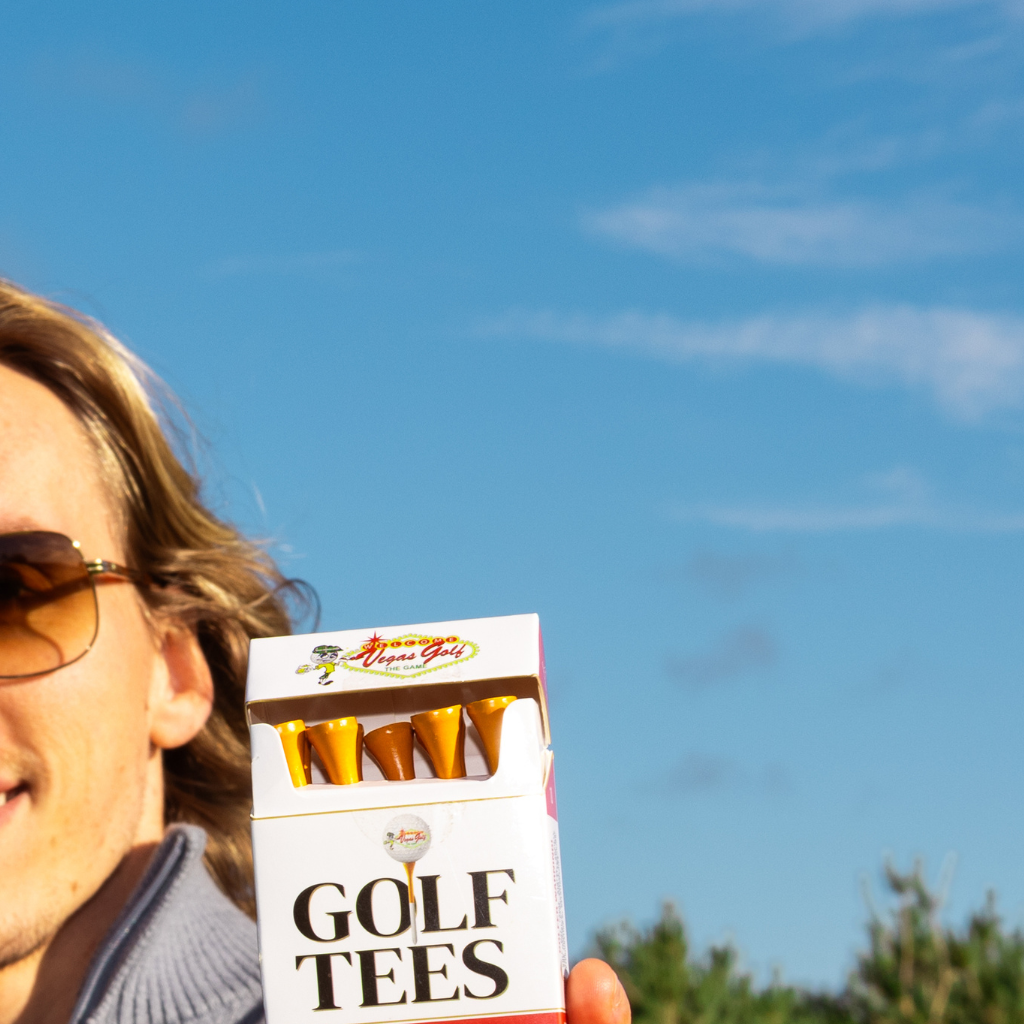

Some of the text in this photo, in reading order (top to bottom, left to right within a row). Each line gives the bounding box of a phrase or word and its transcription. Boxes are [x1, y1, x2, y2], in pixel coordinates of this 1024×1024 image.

[354, 640, 466, 667] Vegas Golf
[362, 636, 458, 650] WELCOME
[293, 868, 516, 943] GOLF
[295, 938, 509, 1012] TEES
